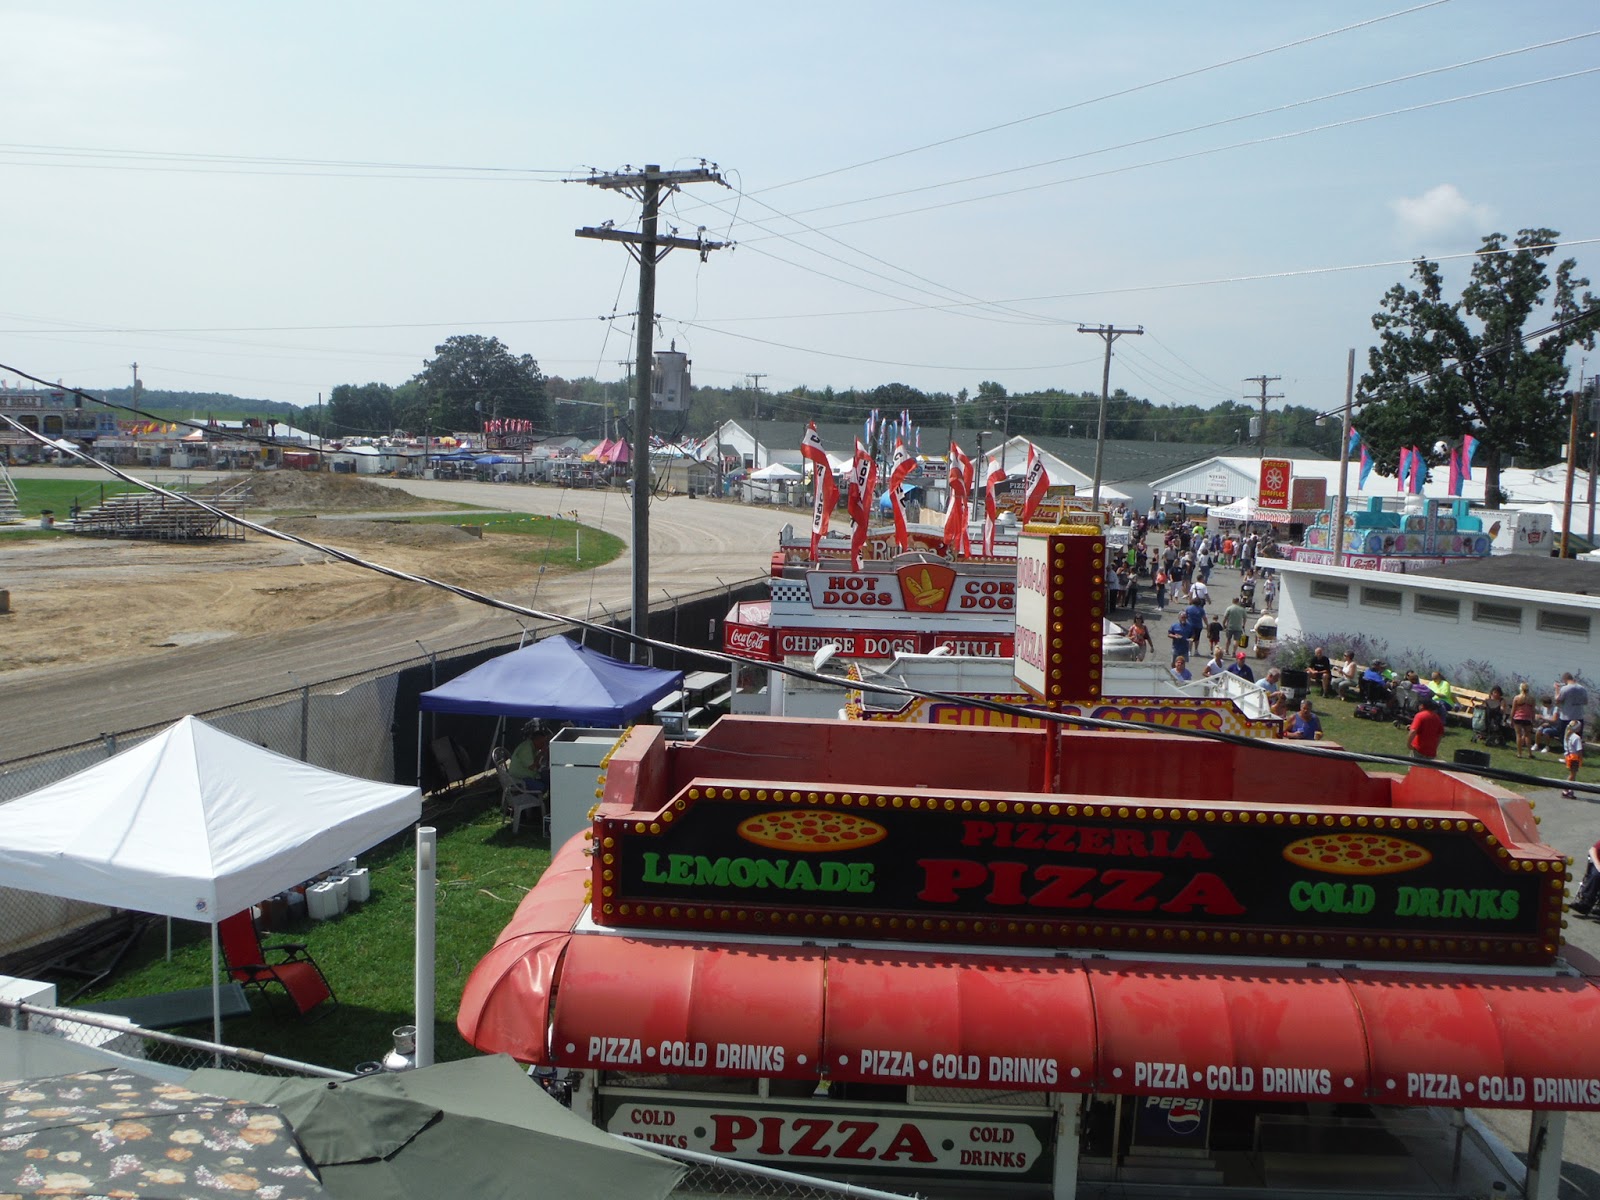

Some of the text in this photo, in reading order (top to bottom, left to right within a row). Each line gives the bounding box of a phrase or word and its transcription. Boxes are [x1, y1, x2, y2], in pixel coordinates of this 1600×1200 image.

[822, 591, 893, 606] DOGS
[828, 576, 878, 591] HOT
[965, 581, 1016, 595] COR
[960, 596, 1016, 609] DOG
[864, 638, 914, 654] DOGS
[1014, 624, 1045, 673] PIZZA
[961, 820, 1213, 859] PIZZERIA
[642, 852, 876, 893] LEMONADE
[916, 859, 1246, 915] PIZZA
[1289, 881, 1520, 920] COLD DRINKS
[588, 1036, 785, 1072] PIZZA COLD DRINKS
[860, 1049, 1058, 1084] PIZZA COLD DRINKS
[1135, 1062, 1332, 1095] PIZZA COLD DRINKS
[1407, 1073, 1600, 1105] PIZZA COLD DRINKS
[630, 1109, 676, 1127] COLD
[1145, 1096, 1204, 1111] PEPSI
[709, 1114, 938, 1164] PIZZA
[969, 1126, 1015, 1144] COLD
[960, 1149, 1027, 1169] DRINKS
